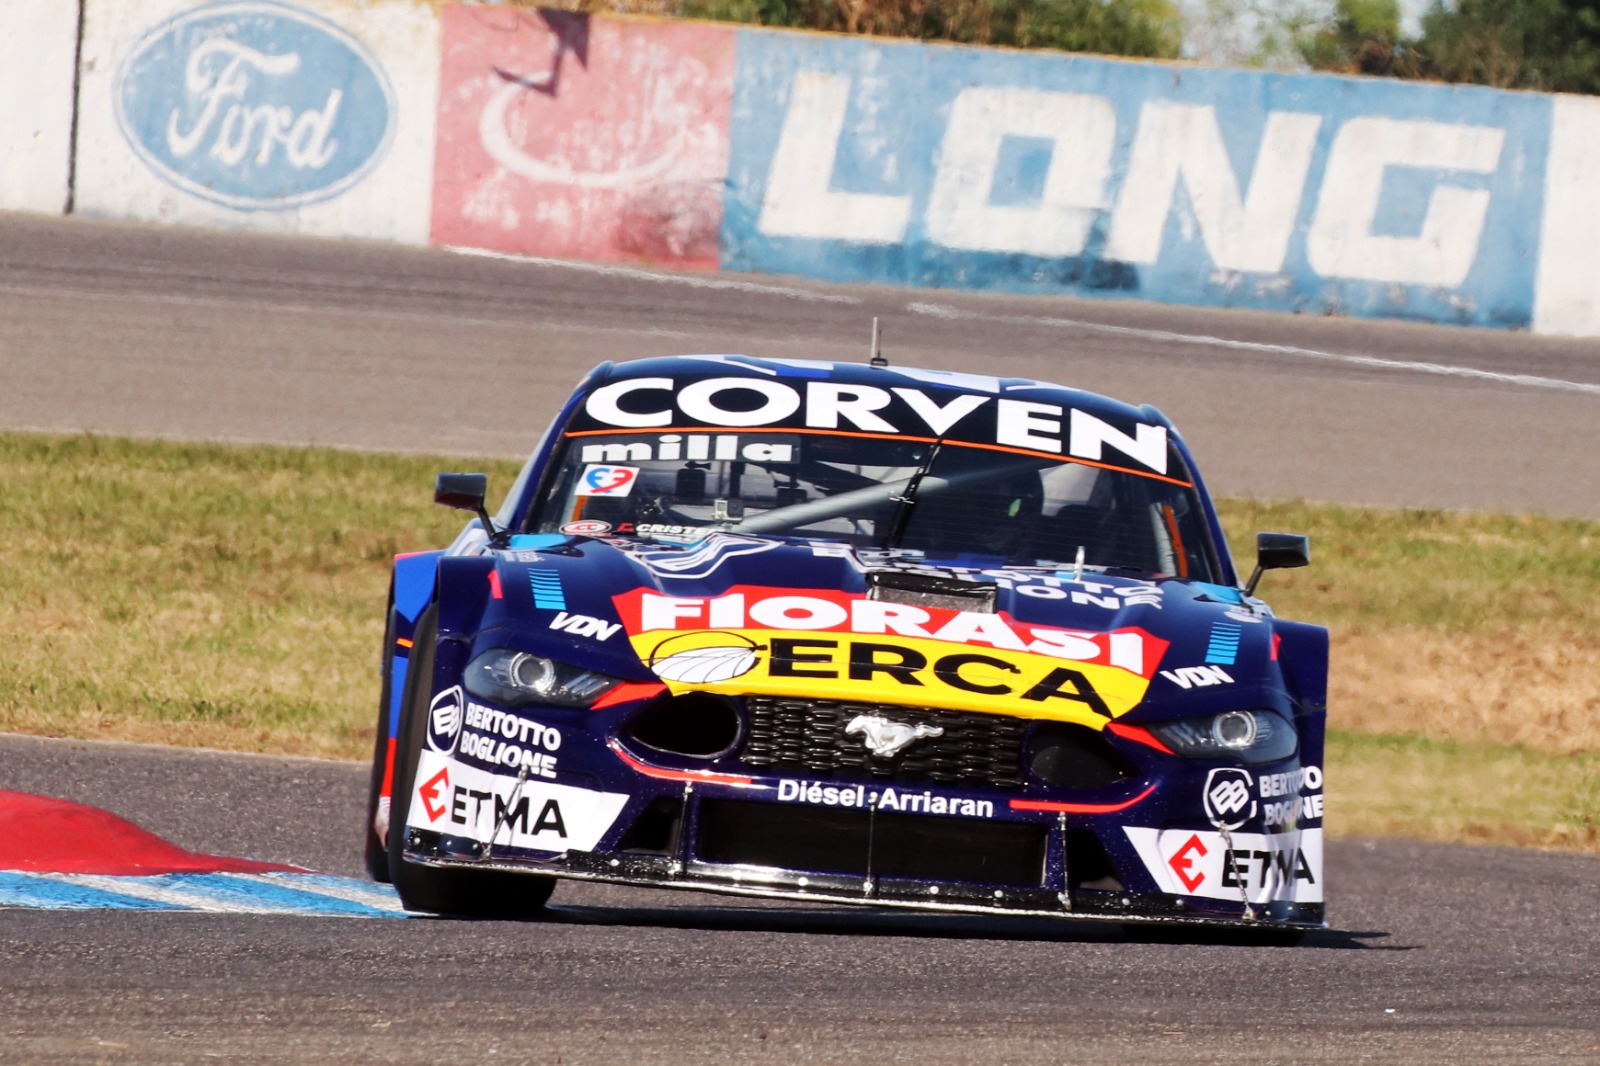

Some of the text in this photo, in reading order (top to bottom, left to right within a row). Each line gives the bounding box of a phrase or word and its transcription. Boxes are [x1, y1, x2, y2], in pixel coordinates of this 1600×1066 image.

[166, 37, 342, 169] Ford
[757, 72, 1506, 287] LONG
[581, 434, 793, 462] milla
[585, 376, 1168, 476] CORVEN
[549, 611, 623, 642] VDN
[641, 592, 1143, 675] FIORASI
[1159, 665, 1236, 690] VDN
[464, 702, 562, 752] BERTOTTO
[459, 730, 558, 779] BOGLIONE
[450, 784, 569, 839] ETMA
[777, 779, 994, 818] Diésel Arriaran
